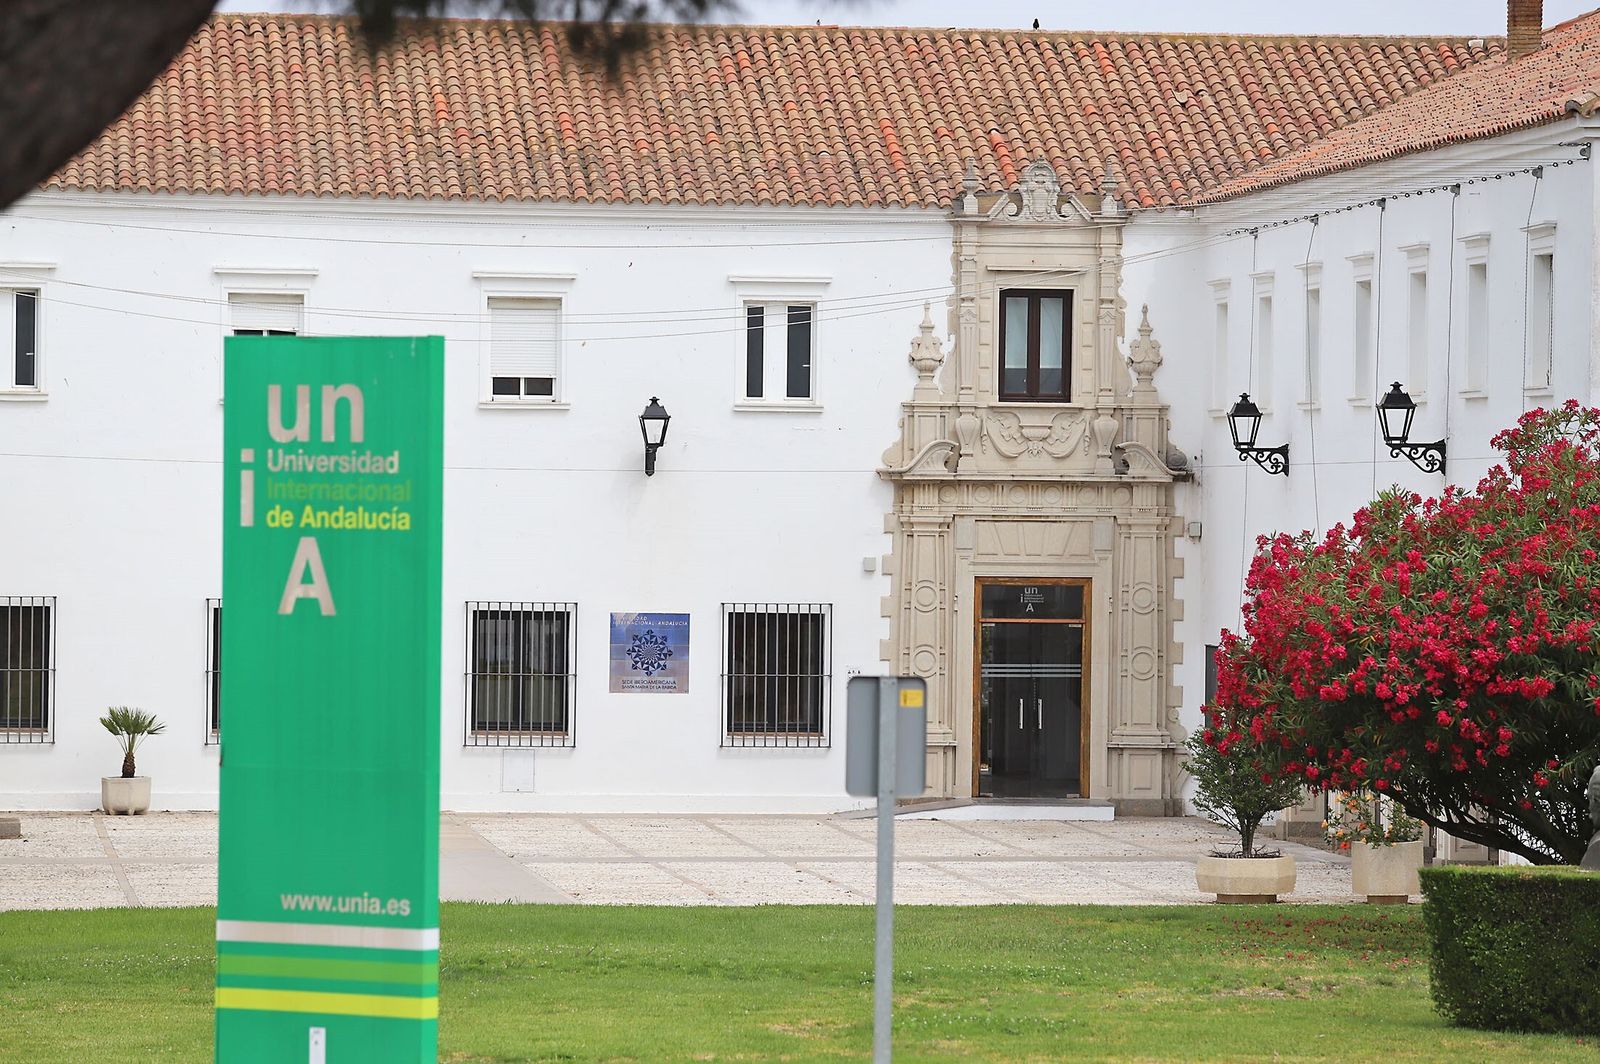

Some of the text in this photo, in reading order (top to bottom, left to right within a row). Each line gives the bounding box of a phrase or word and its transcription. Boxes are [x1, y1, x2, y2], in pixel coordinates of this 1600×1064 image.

[267, 383, 364, 444] un
[266, 449, 399, 474] Universidad
[266, 477, 412, 502] Internacional
[266, 504, 411, 530] de Andalucía
[277, 536, 337, 616] A
[280, 892, 412, 917] www.unia.es
